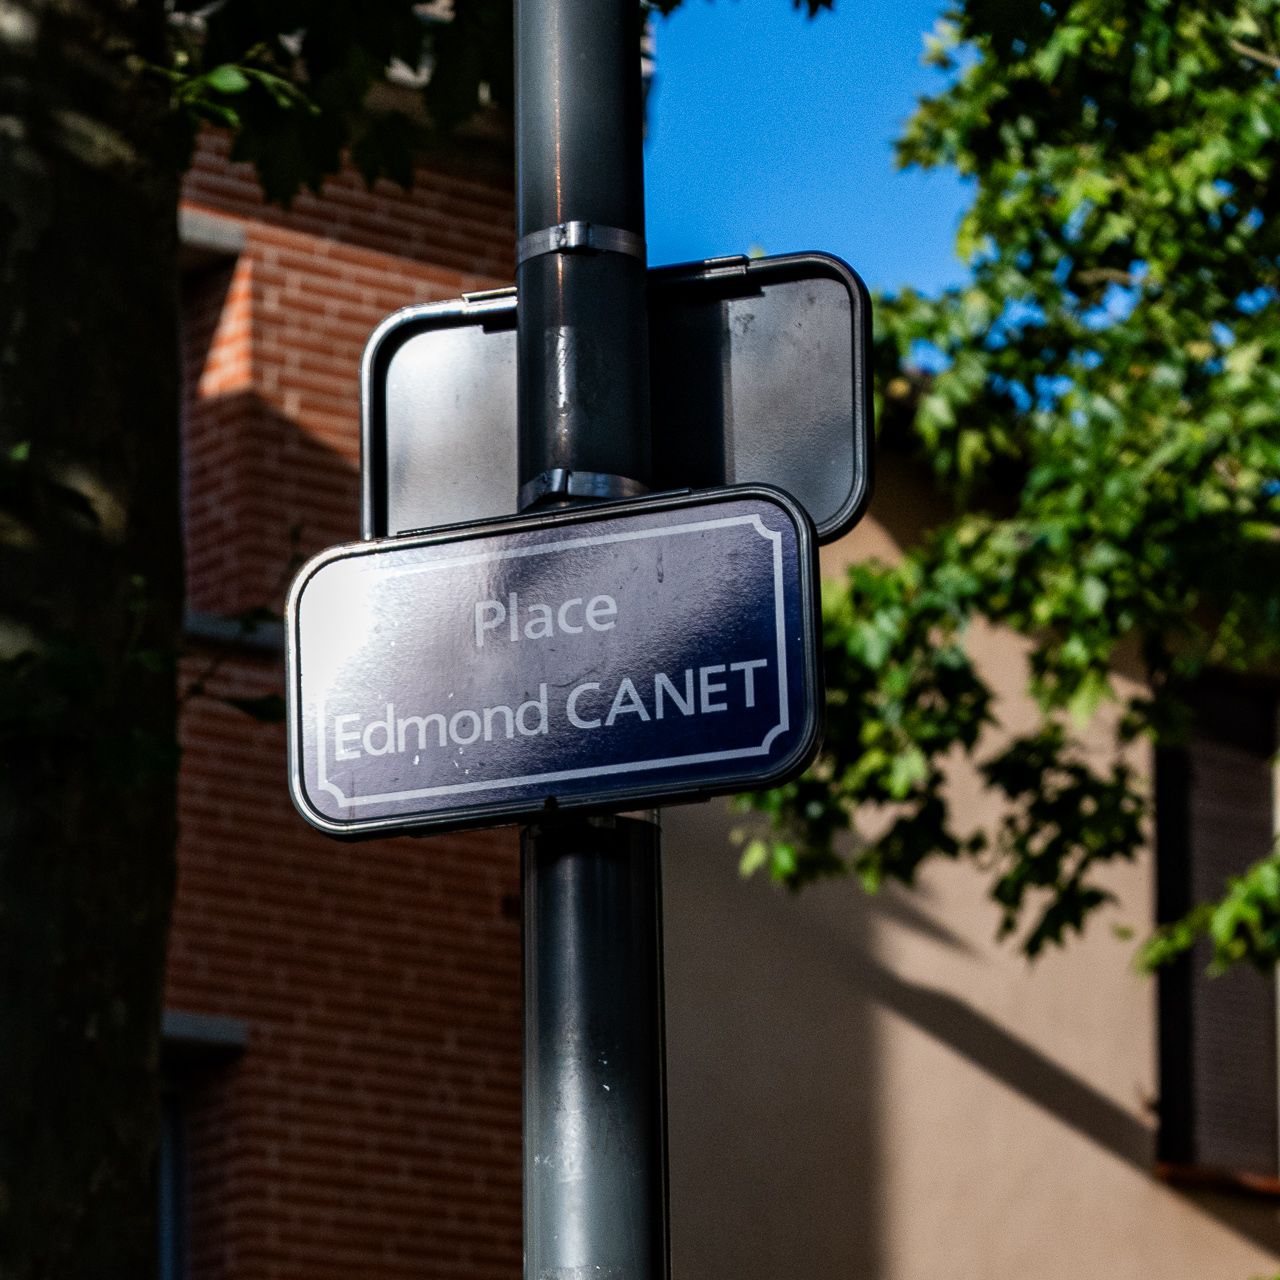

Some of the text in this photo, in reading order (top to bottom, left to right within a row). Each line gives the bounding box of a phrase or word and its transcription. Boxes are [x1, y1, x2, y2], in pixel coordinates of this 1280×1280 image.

[474, 593, 618, 648] Place
[334, 658, 768, 762] Edmond CANET
